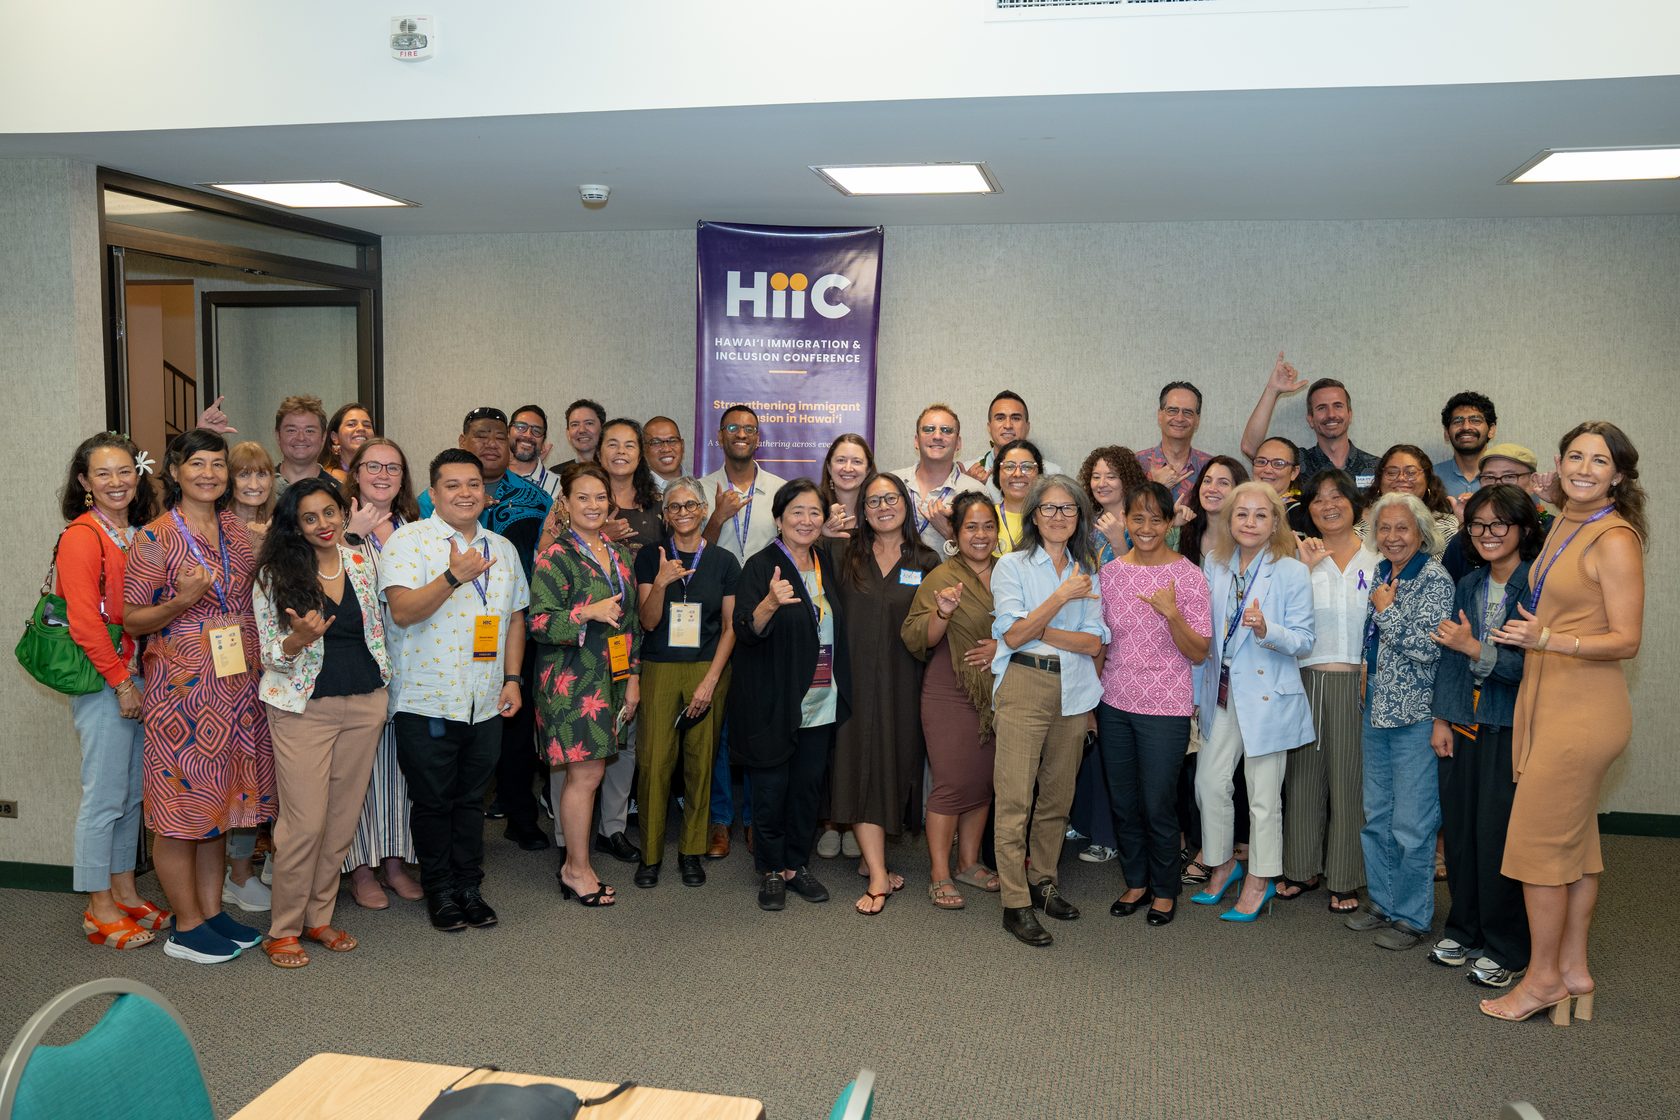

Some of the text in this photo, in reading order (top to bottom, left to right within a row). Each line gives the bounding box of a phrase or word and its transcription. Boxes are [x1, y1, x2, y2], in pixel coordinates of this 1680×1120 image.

[726, 270, 851, 319] HiiC
[767, 338, 849, 349] IMMIGRATION
[852, 340, 861, 349] &
[715, 351, 861, 363] INCLUSION CONFERENCE
[798, 400, 861, 413] immigrant
[786, 413, 797, 423] in
[708, 439, 714, 447] A
